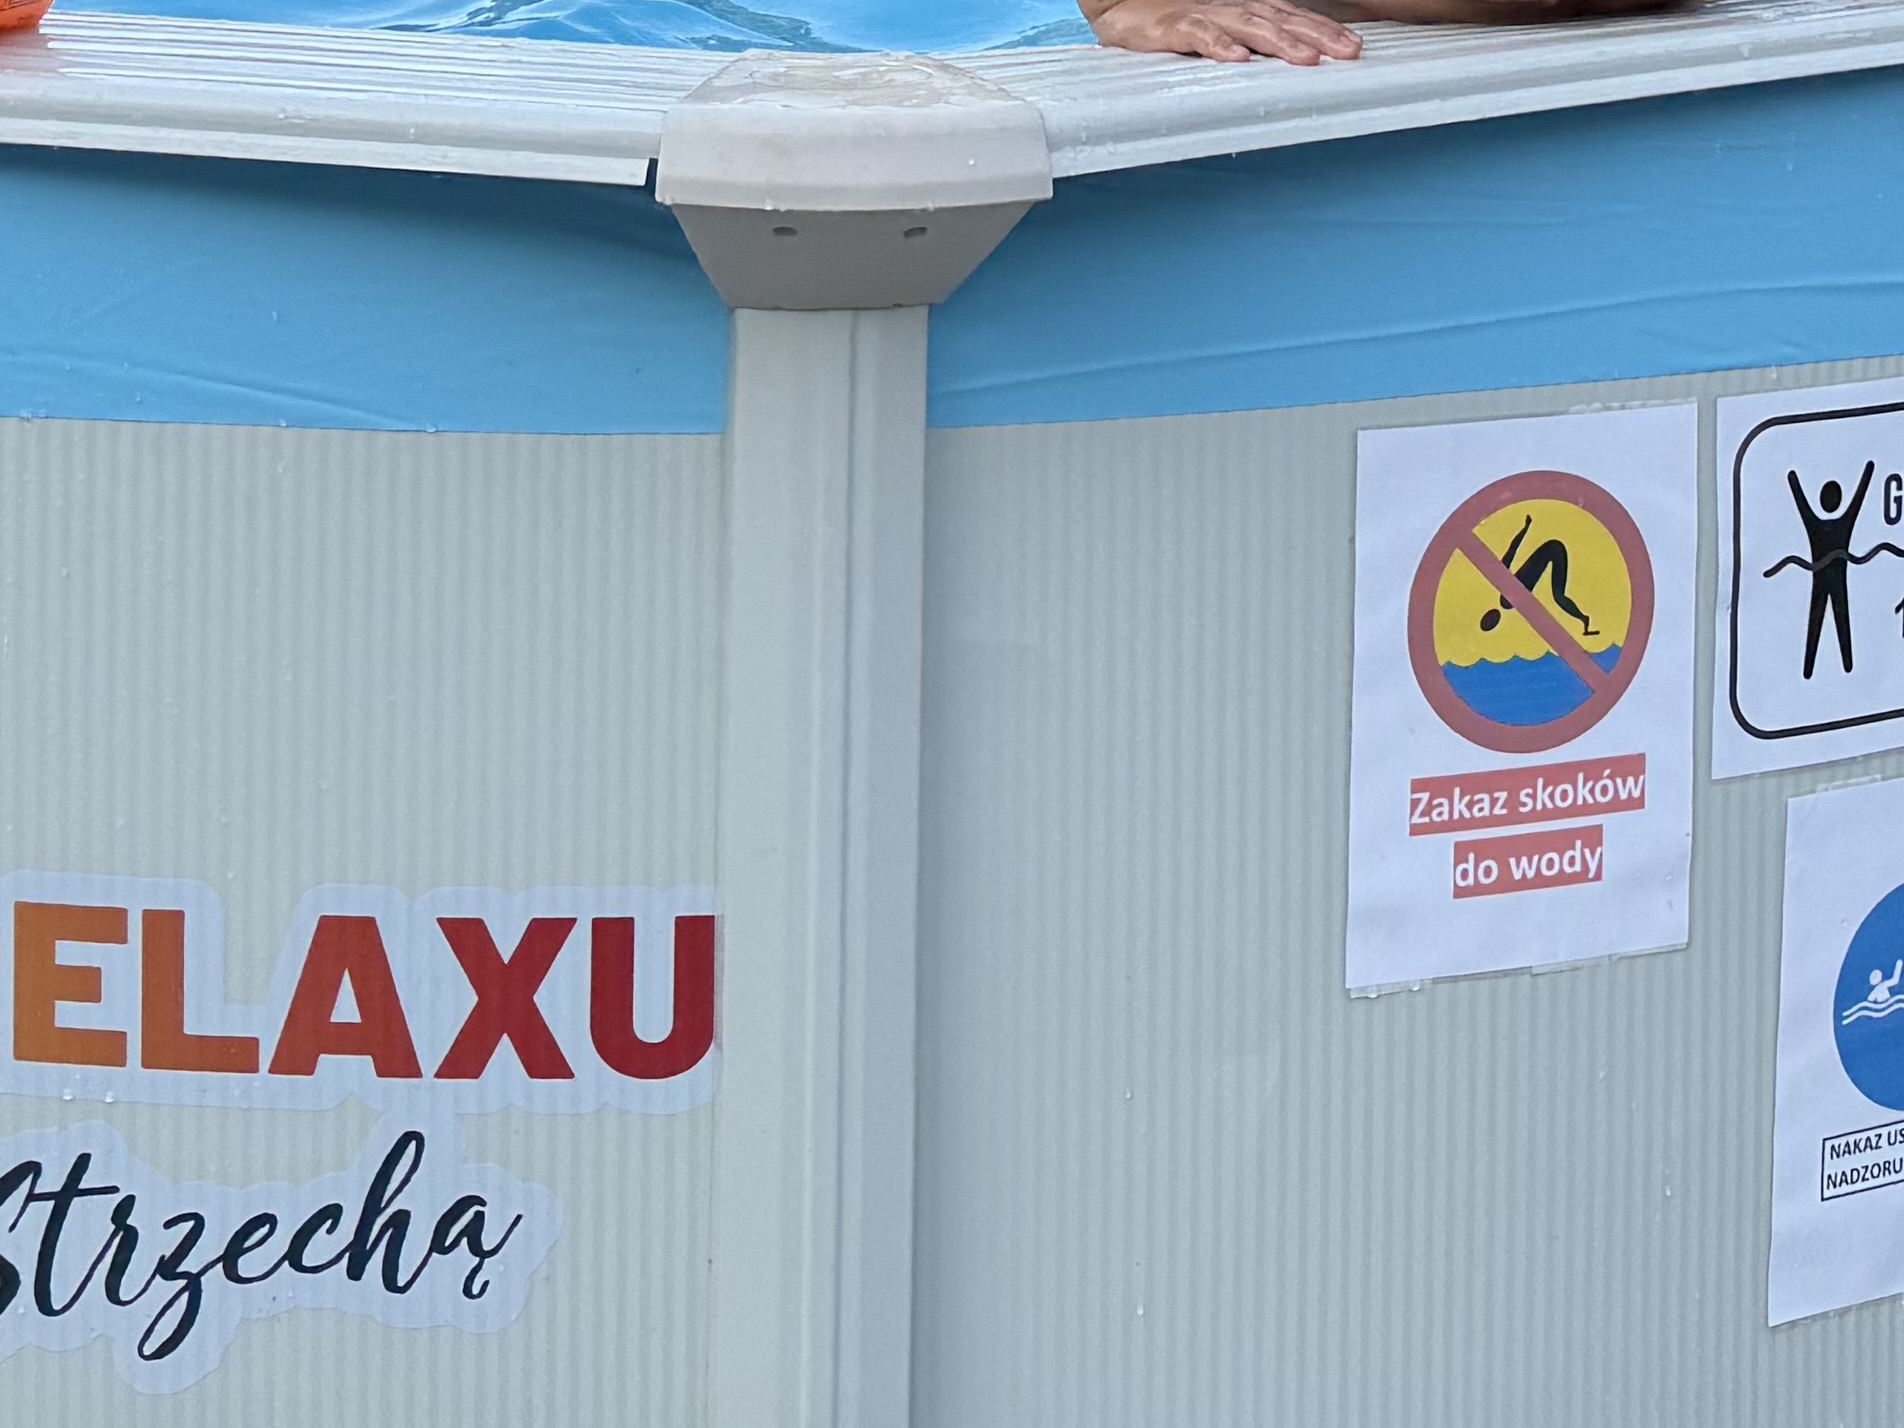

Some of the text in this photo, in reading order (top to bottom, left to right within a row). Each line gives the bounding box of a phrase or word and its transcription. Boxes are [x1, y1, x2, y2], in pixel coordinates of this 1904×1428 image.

[1410, 769, 1645, 823] Zakaz skoków
[1455, 840, 1602, 887] do wody
[1830, 1133, 1883, 1160] NAKAZ
[1826, 1157, 1903, 1190] NADZORU
